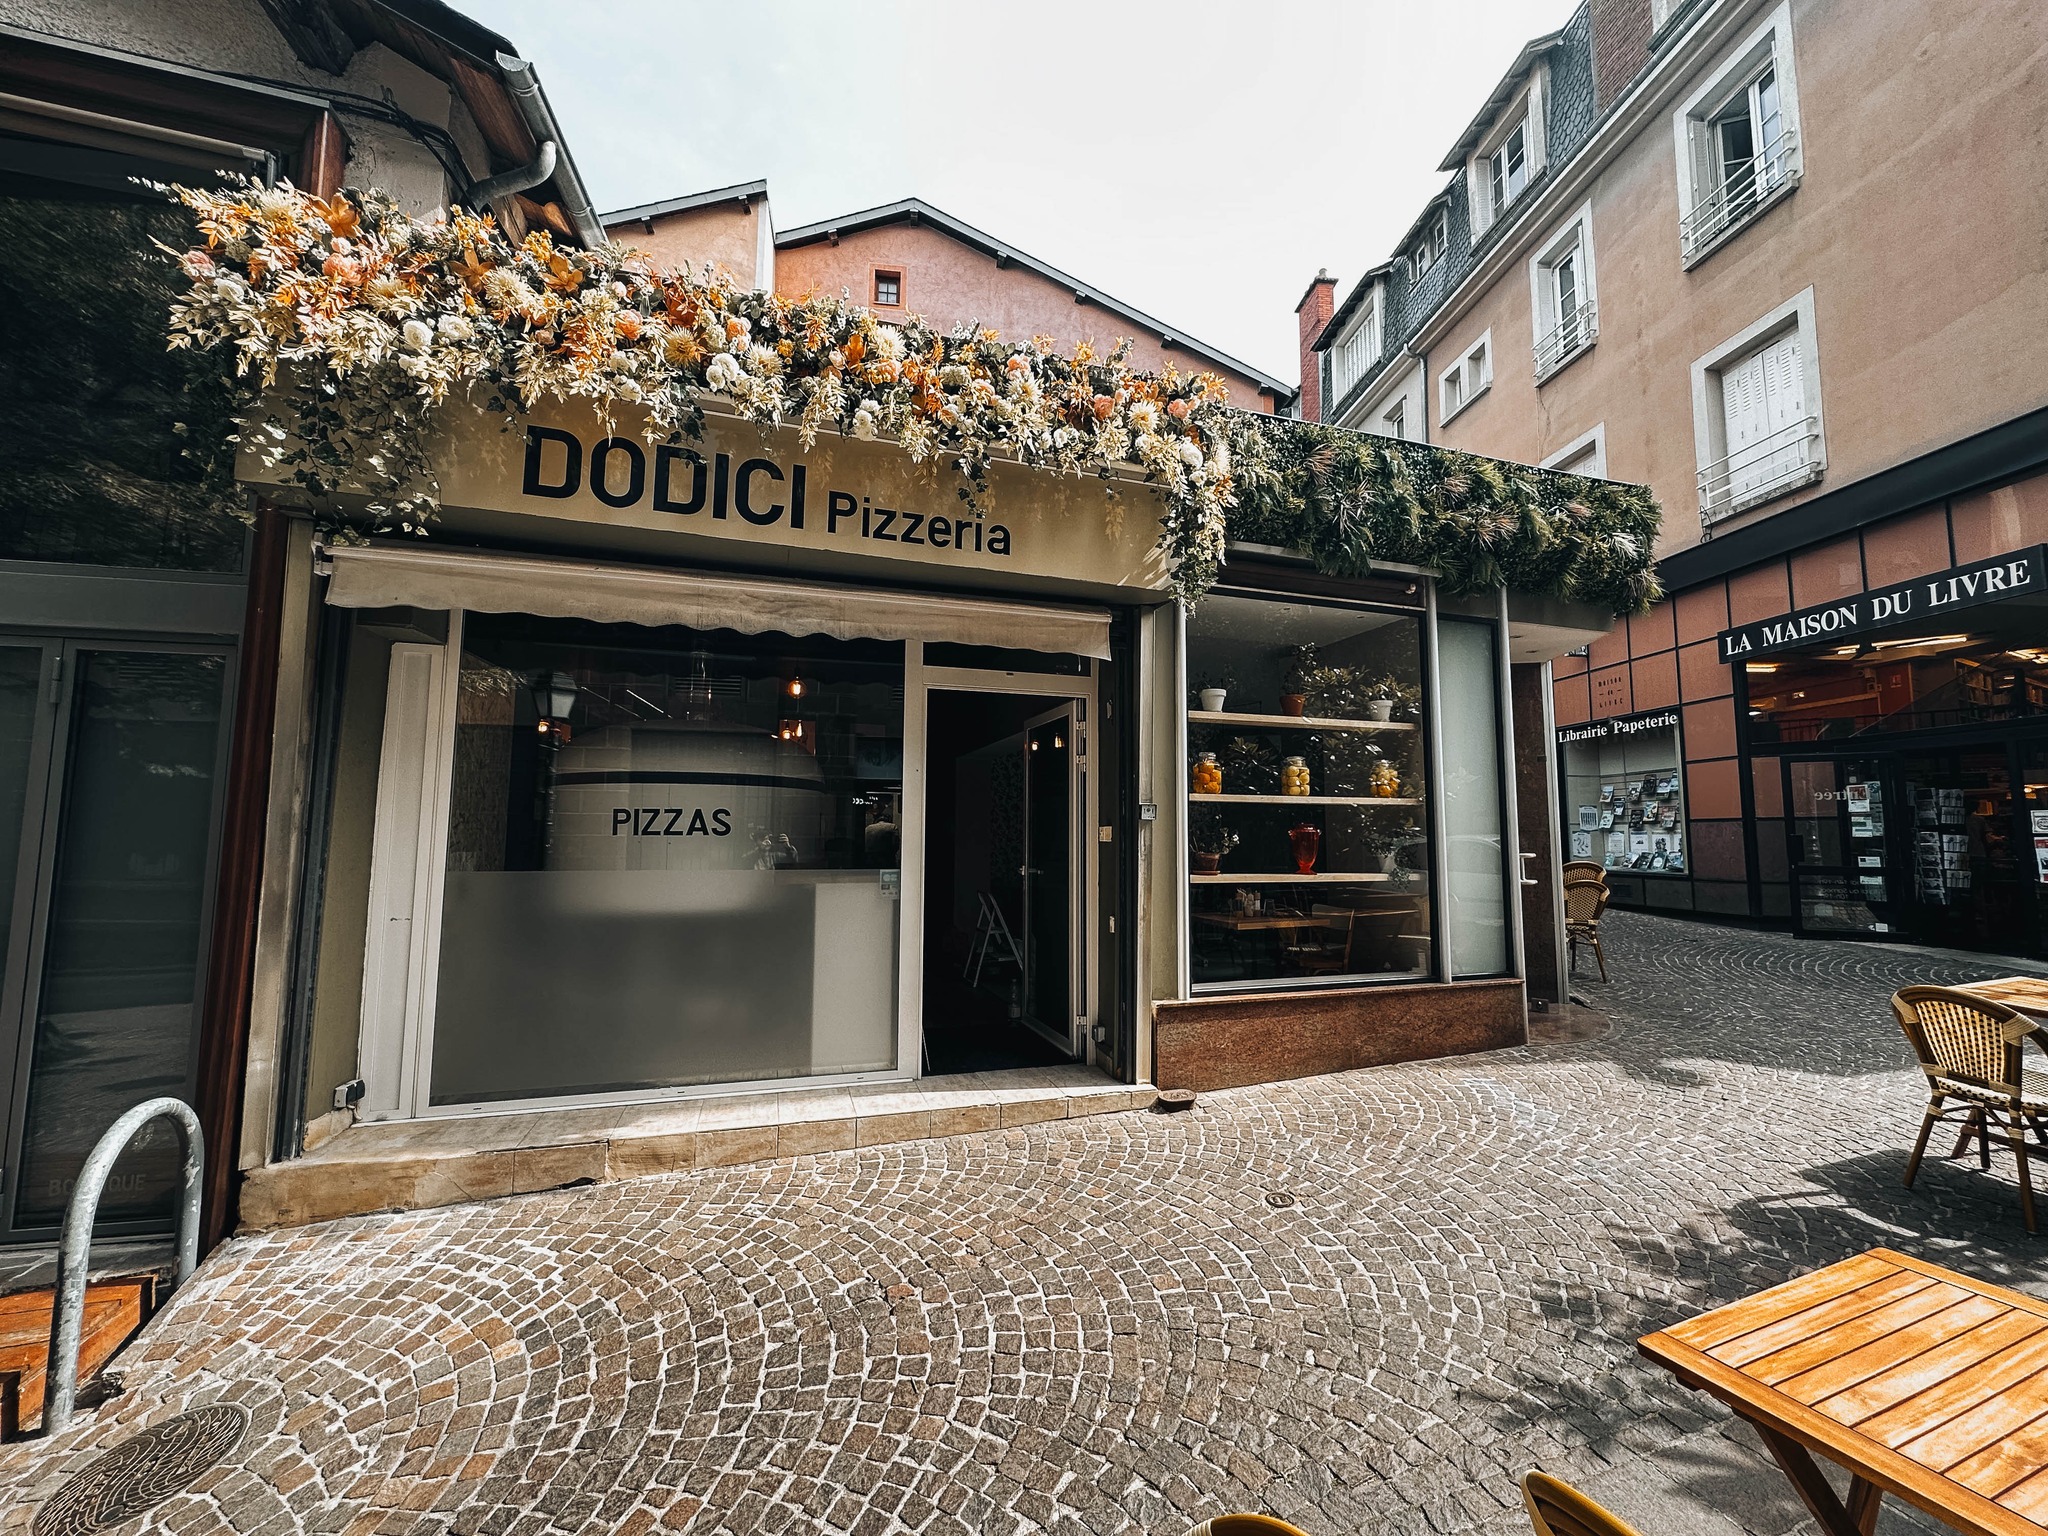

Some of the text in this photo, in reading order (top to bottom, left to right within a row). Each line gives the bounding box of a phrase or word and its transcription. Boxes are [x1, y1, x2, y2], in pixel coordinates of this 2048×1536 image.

[522, 424, 1012, 557] DODICI Pizzeria
[1726, 559, 2031, 656] LA MAISON DU LIVRE
[1558, 724, 1608, 743] Librairie
[1613, 712, 1679, 734] Papeterie
[612, 808, 732, 837] PIZZAS
